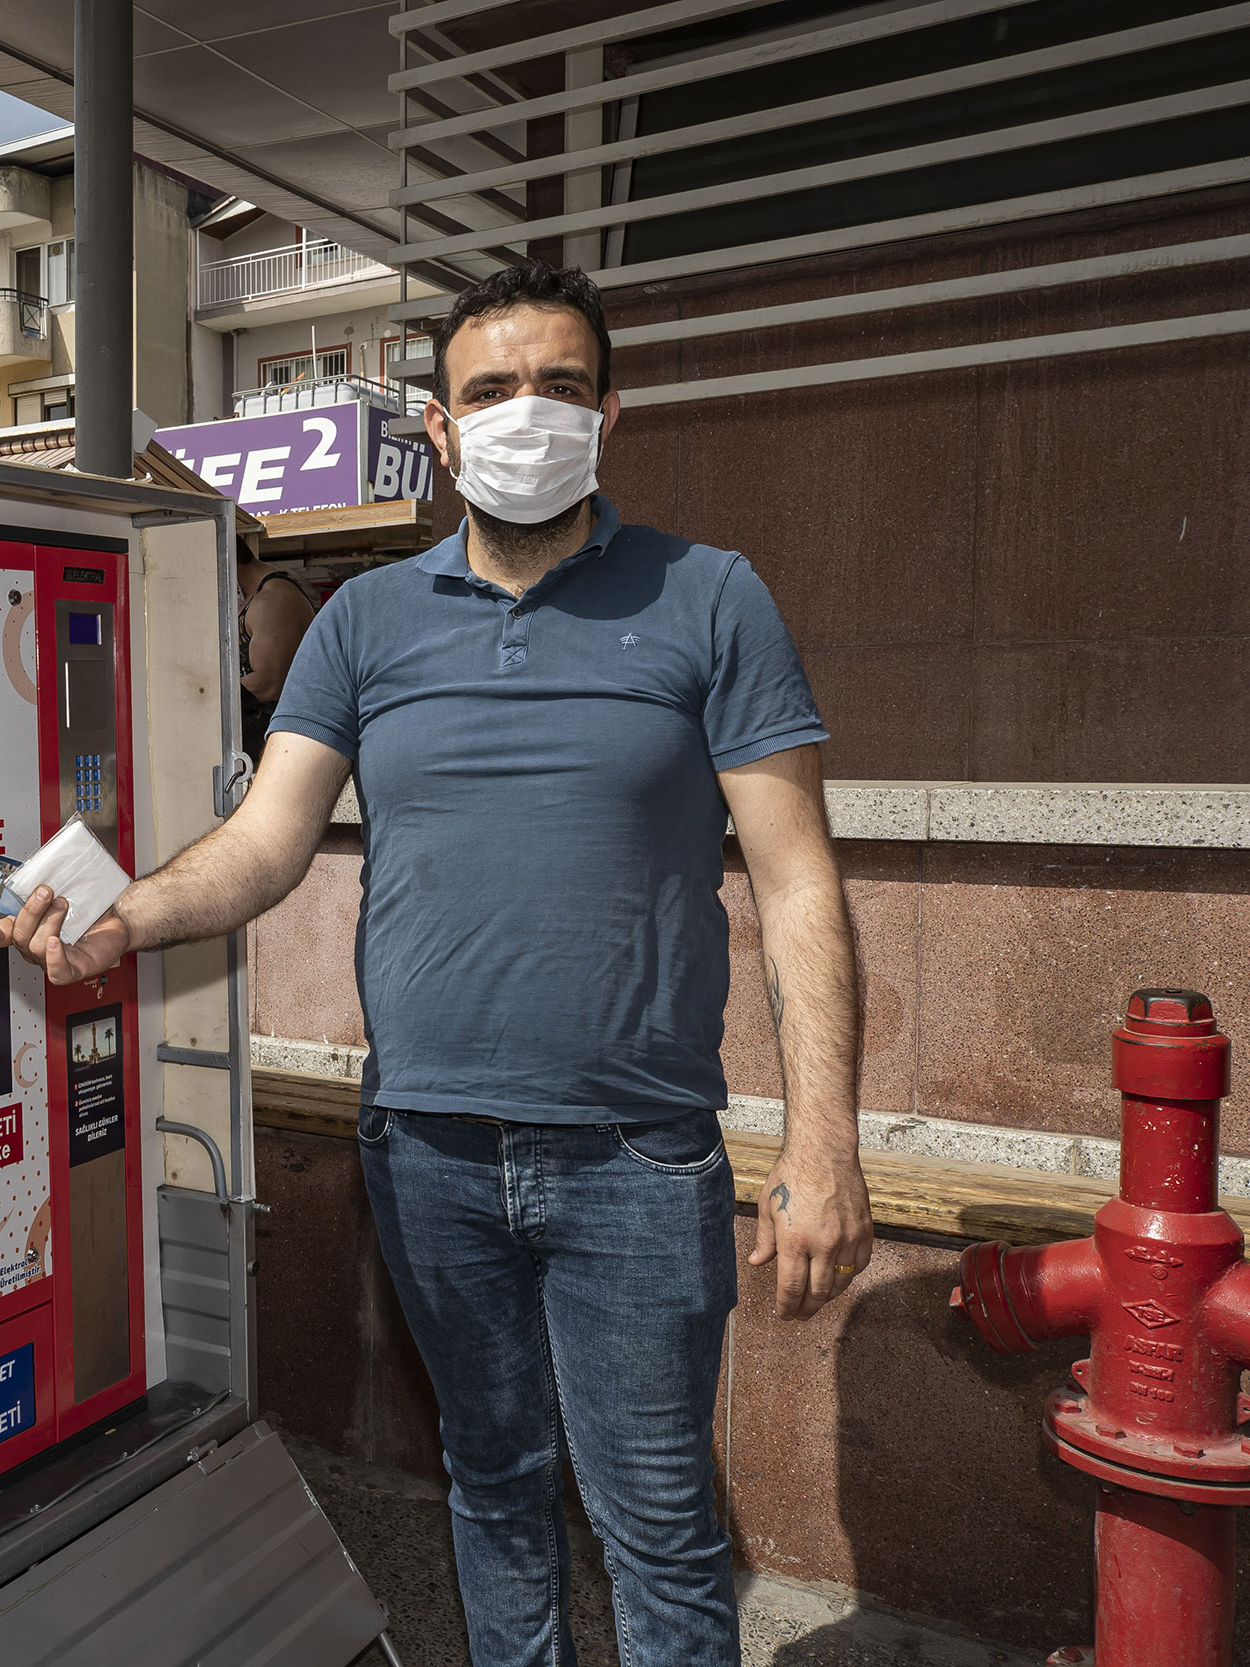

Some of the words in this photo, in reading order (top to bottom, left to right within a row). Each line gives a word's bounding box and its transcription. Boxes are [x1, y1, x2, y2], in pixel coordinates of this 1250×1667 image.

[167, 446, 291, 504] FE
[300, 417, 341, 471] 2
[374, 442, 433, 501] BÜ
[0, 1265, 42, 1288] Üretilmiştir.
[1136, 1306, 1166, 1323] TSE
[1124, 1334, 1183, 1362] ASFAR
